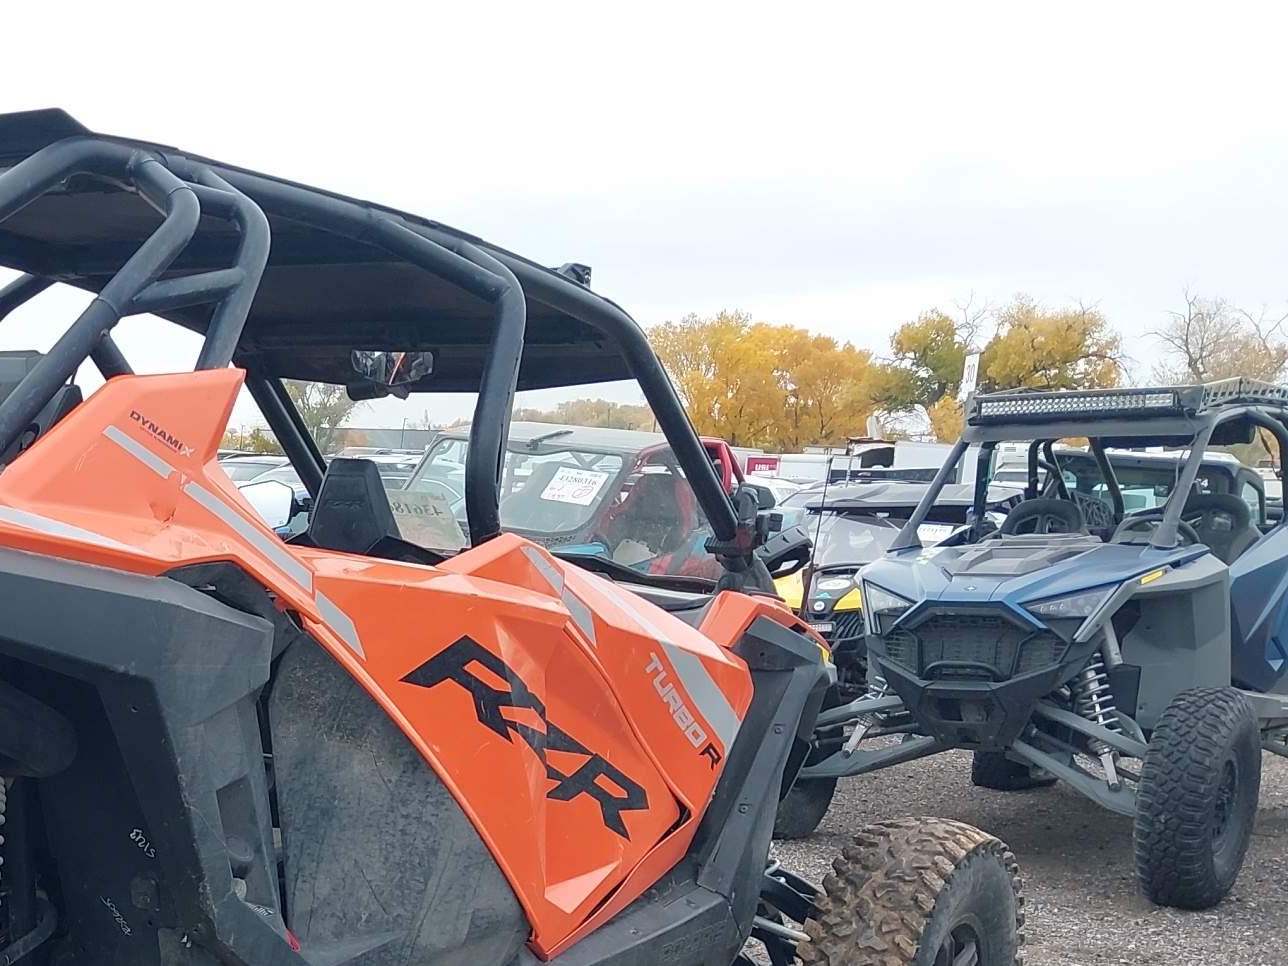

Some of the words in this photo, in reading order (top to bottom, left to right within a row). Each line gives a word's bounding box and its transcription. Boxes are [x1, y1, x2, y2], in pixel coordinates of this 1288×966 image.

[398, 634, 649, 842] RZR
[644, 652, 708, 749] TURBO
[699, 742, 722, 771] R
